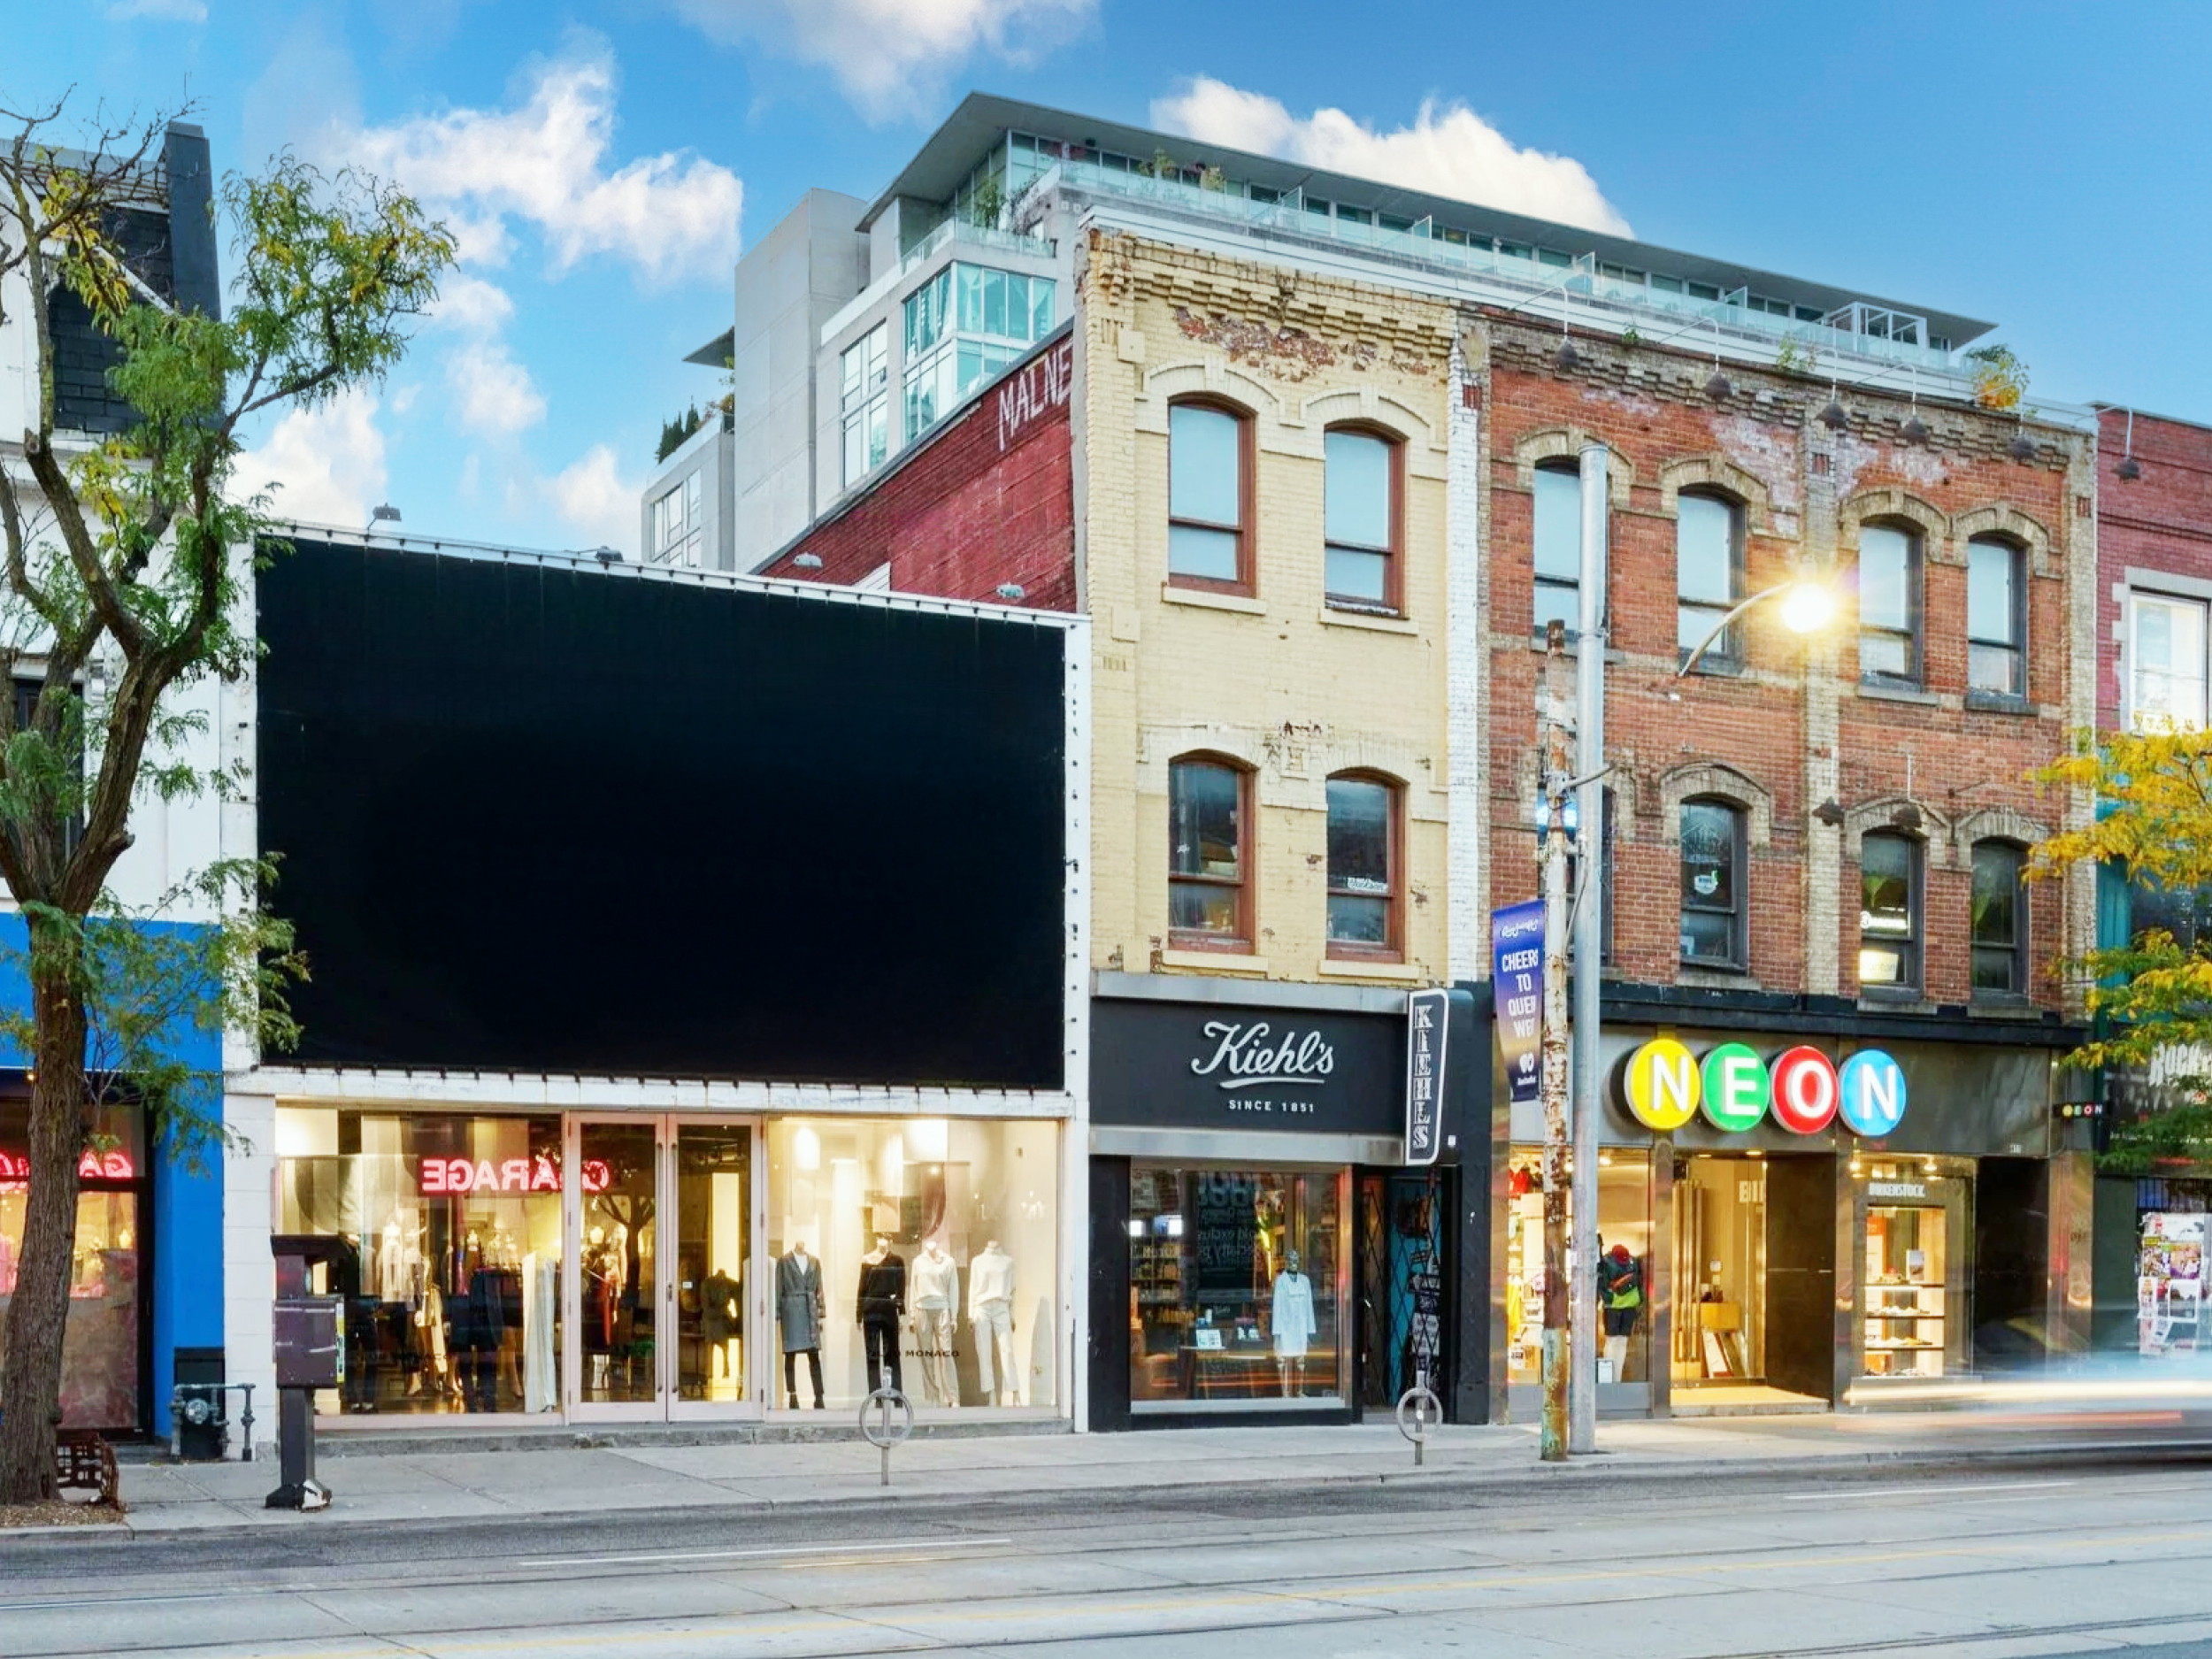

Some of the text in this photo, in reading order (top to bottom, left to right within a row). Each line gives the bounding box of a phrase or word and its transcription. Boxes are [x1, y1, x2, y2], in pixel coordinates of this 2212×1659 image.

[1515, 973, 1532, 992] TO
[1190, 1020, 1334, 1075] Kiehl's
[1413, 1004, 1433, 1149] KIEHLS
[1649, 1053, 1899, 1120] NEON
[1229, 1099, 1315, 1114] SINCE 1851
[905, 1349, 960, 1358] MONACO
